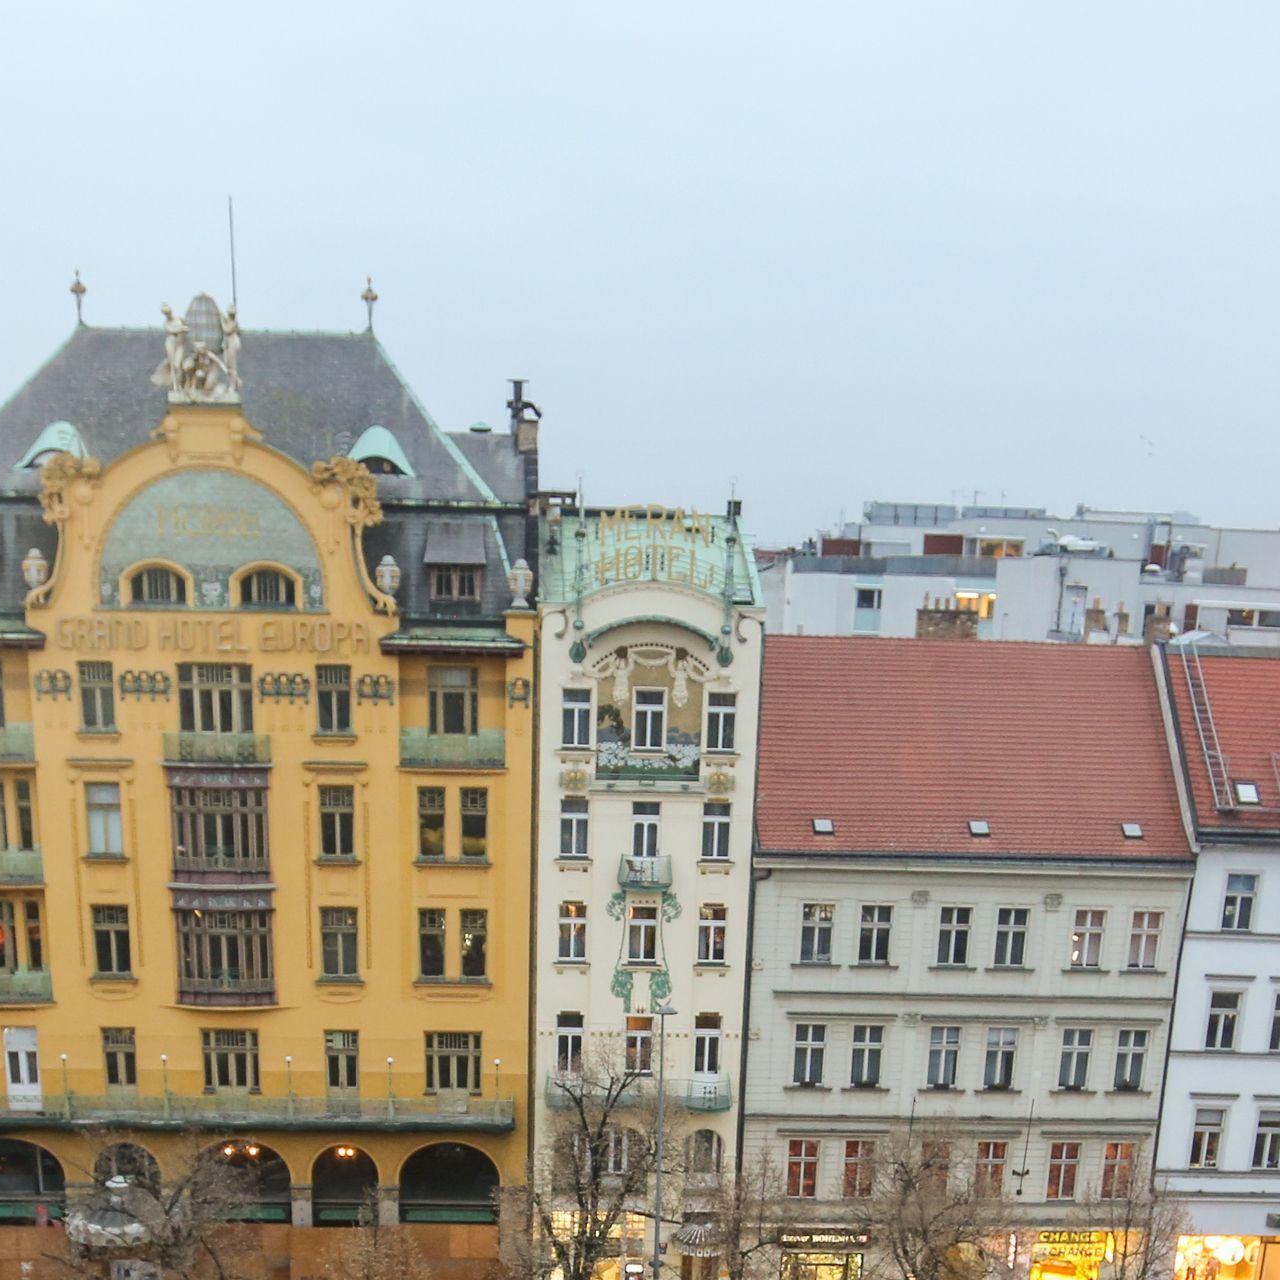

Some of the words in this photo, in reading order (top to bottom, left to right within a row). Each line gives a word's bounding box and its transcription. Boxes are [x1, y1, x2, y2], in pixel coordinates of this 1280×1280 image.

[600, 504, 712, 548] MERAN
[597, 544, 713, 589] HOTEL
[56, 616, 148, 650] GRAND
[158, 617, 249, 652] HOTEL
[258, 619, 370, 654] EUROPA
[1039, 1231, 1100, 1242] CHANGE
